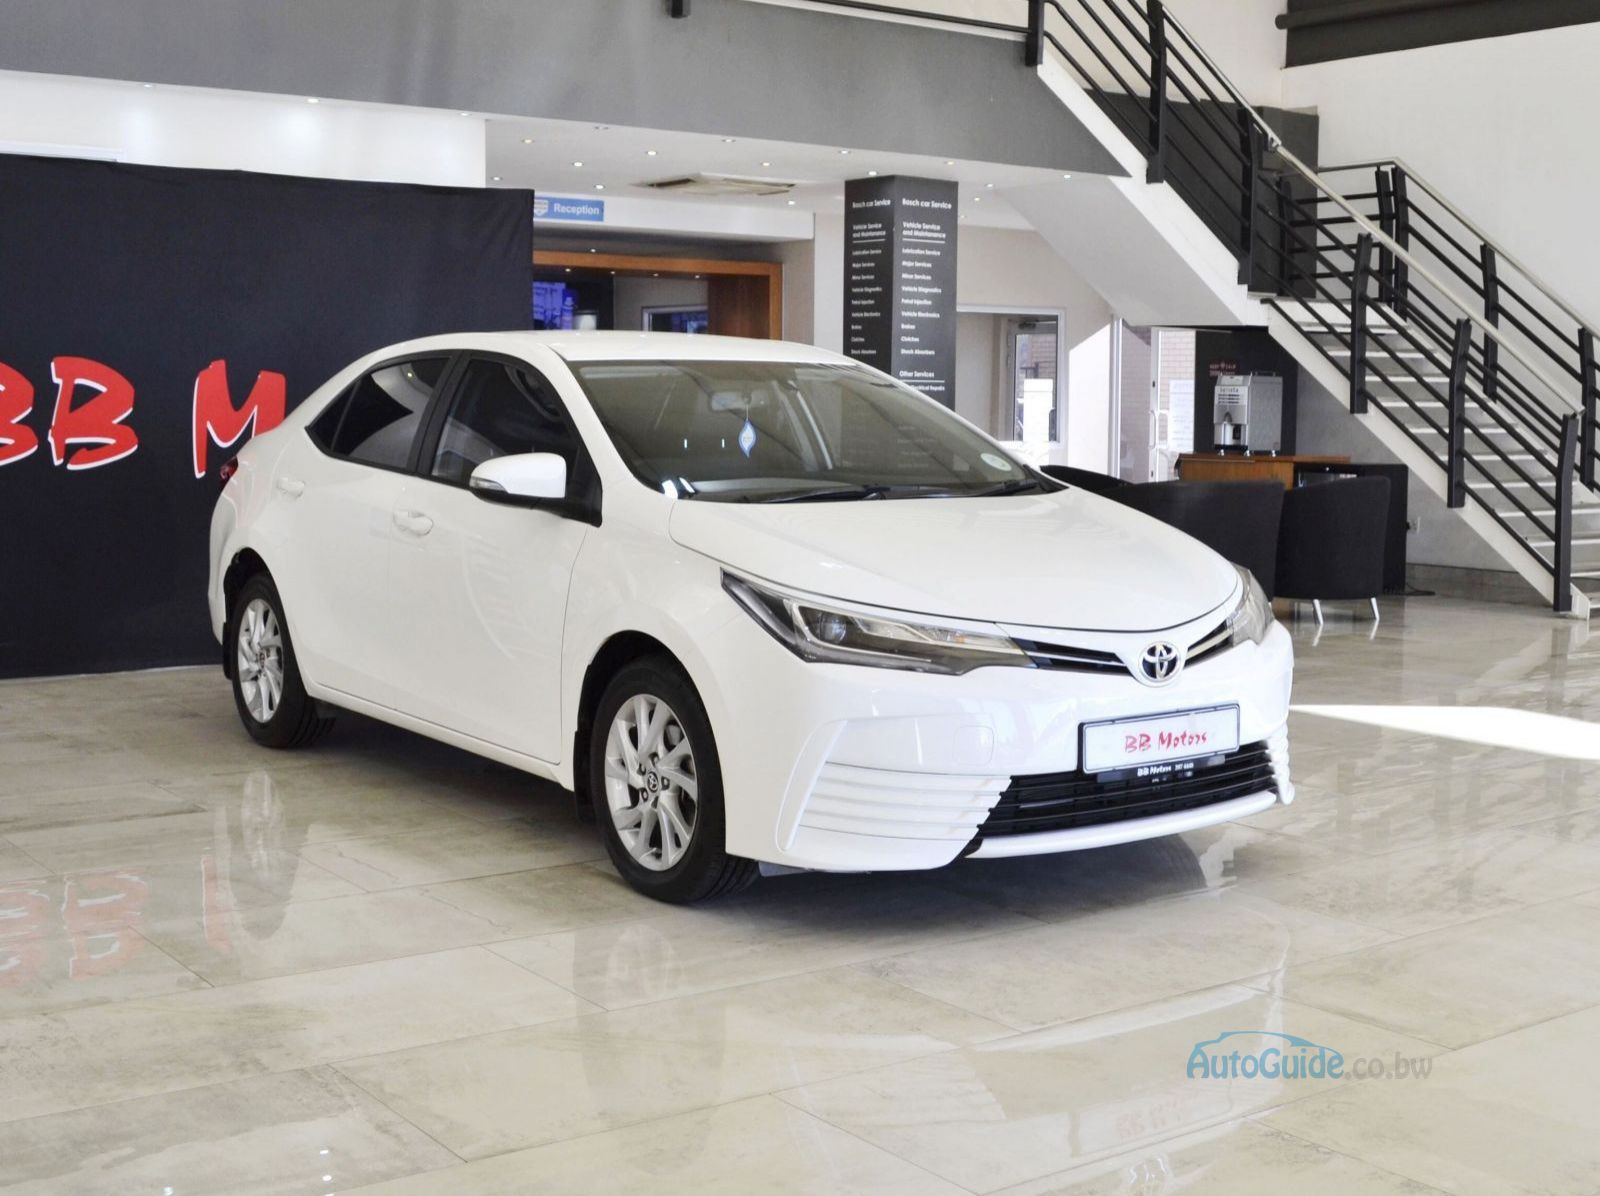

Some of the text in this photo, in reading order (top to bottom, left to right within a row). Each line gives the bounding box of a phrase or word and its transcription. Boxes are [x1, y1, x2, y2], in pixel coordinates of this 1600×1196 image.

[874, 199, 891, 207] Service
[902, 198, 952, 210] Bosch car Service
[553, 202, 600, 216] Reception
[902, 221, 941, 231] Vehicle Service
[899, 370, 935, 378] Other Services
[1125, 730, 1208, 753] BB Motors
[1137, 767, 1150, 777] BB
